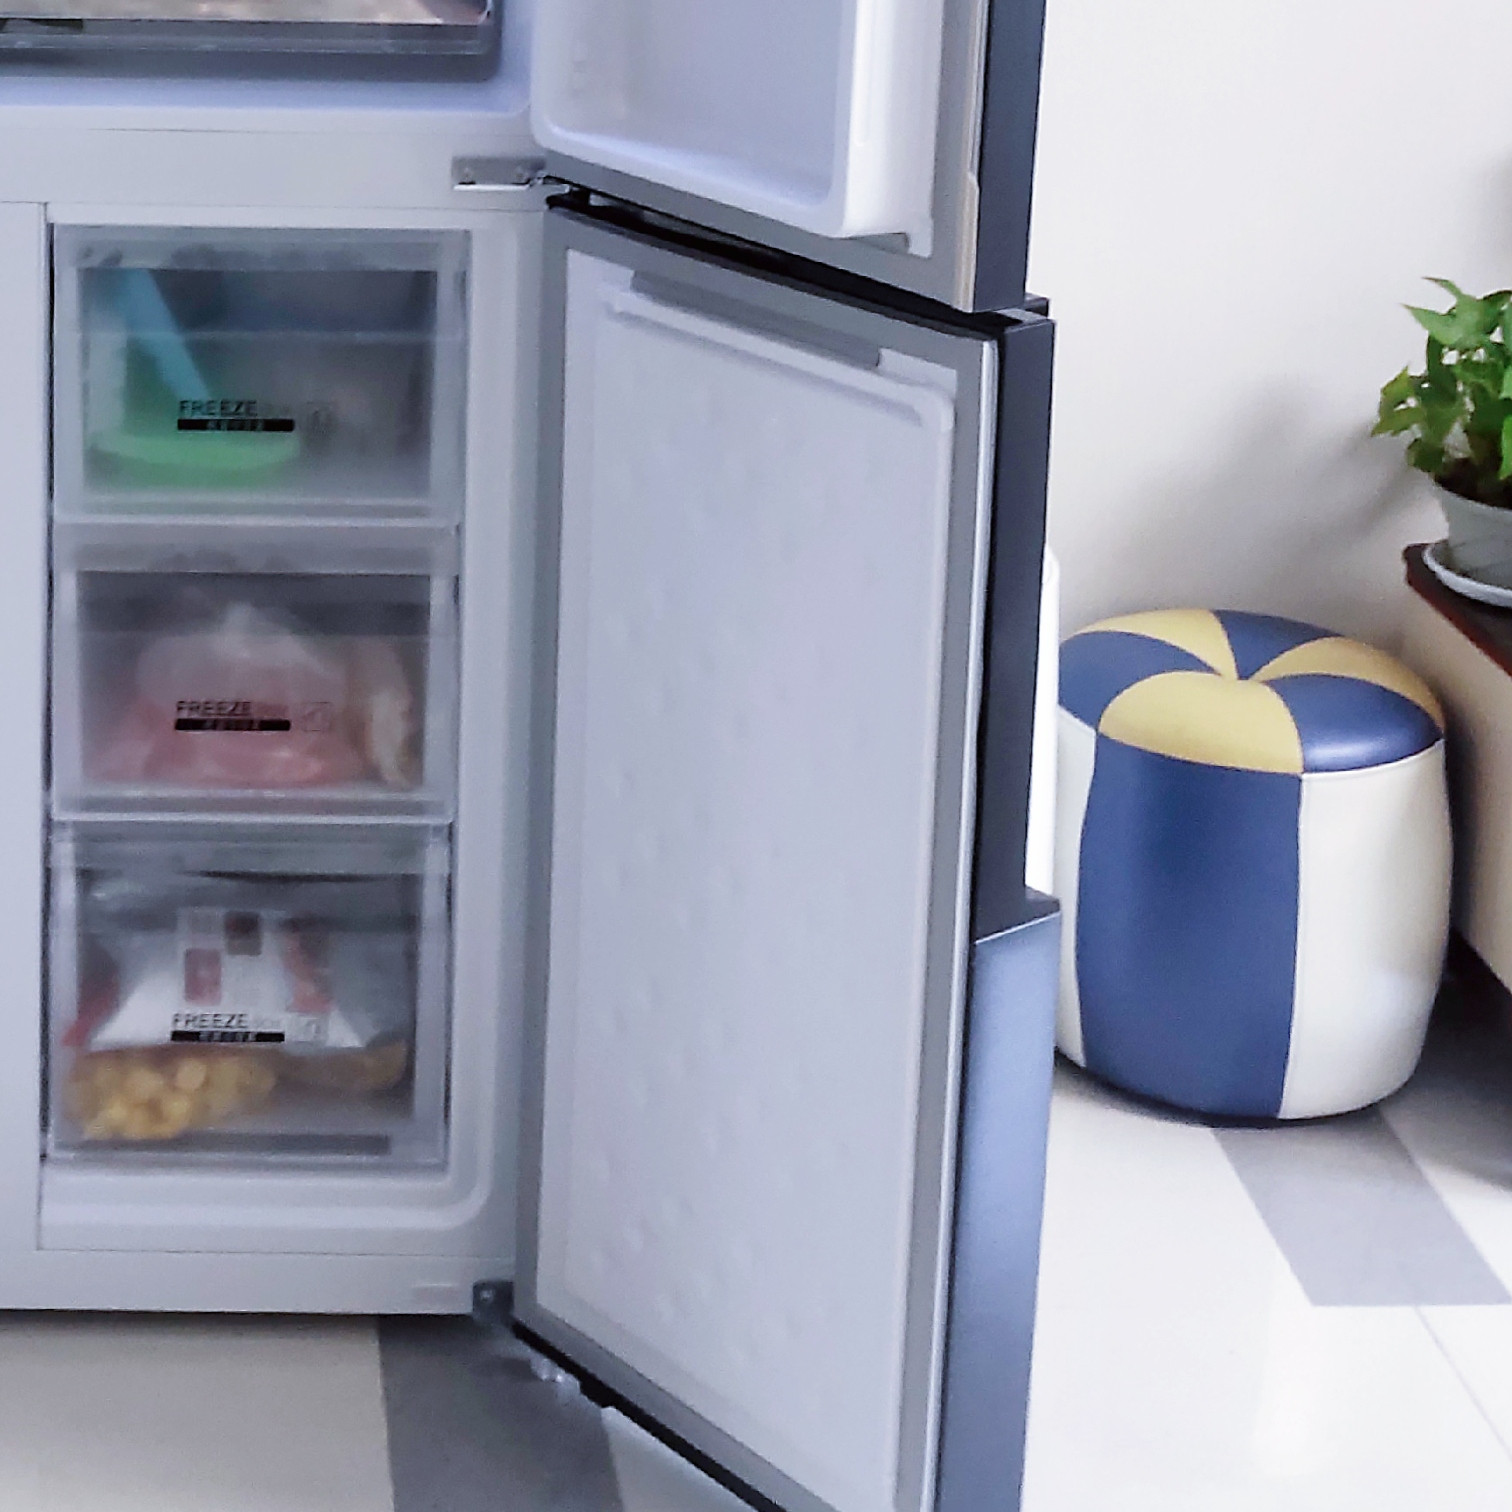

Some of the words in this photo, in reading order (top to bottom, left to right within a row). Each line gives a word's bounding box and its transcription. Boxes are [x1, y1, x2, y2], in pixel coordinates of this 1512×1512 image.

[179, 400, 258, 416] FREEZE
[175, 700, 252, 716] FREEZE
[173, 1013, 248, 1029] FREEZE
